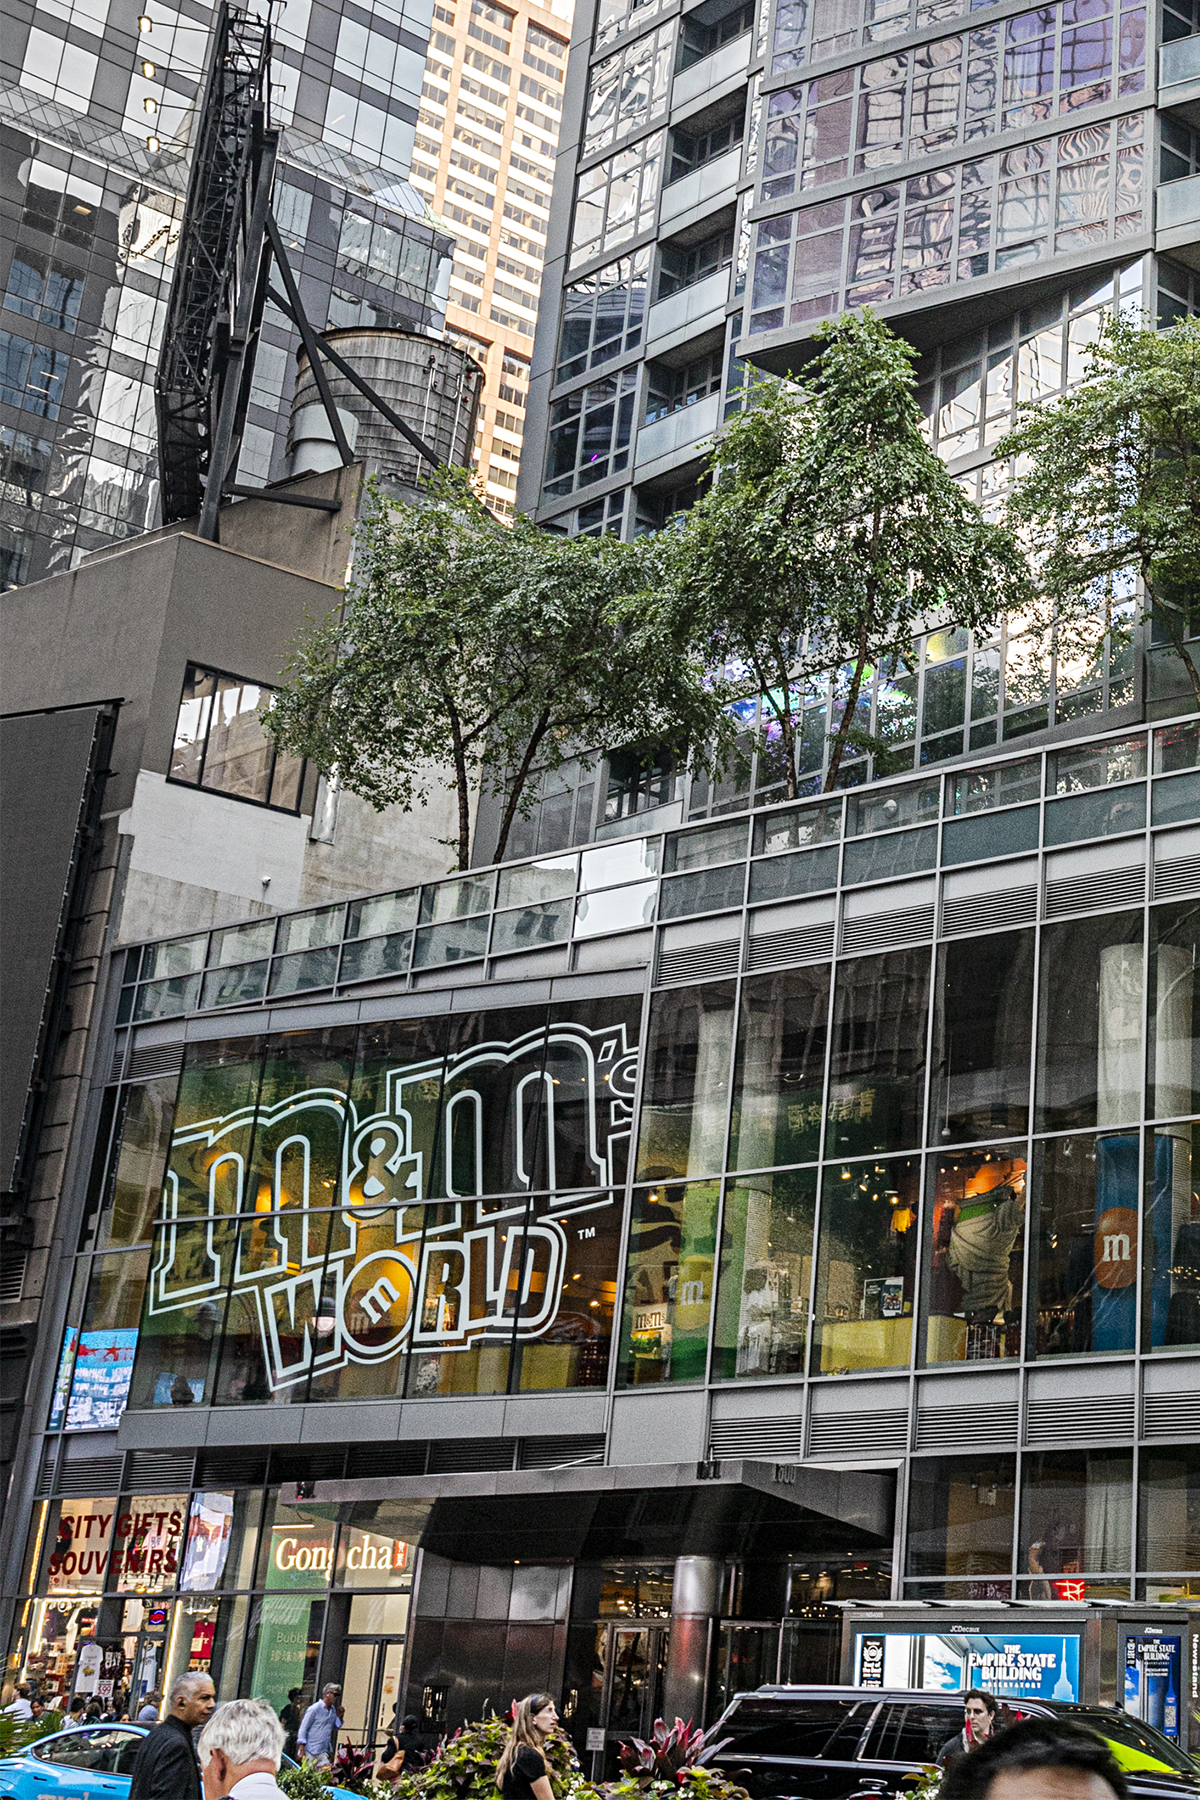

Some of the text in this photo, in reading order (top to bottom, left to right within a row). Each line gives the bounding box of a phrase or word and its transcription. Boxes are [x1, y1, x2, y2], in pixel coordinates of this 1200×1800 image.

[578, 1227, 596, 1240] TM
[1102, 1233, 1131, 1262] m
[264, 1219, 568, 1381] WORLD
[60, 1511, 182, 1539] CITY GIFTS
[347, 1535, 393, 1570] cha
[47, 1549, 178, 1576] SOUVENIRS
[950, 1625, 980, 1633] JCDecaux
[1004, 1645, 1021, 1654] THE
[1138, 1644, 1175, 1653] EMPIRE STATE
[969, 1653, 1056, 1668] EMPIRE STATE
[1144, 1652, 1170, 1660] BUILDING
[981, 1667, 1042, 1680] BUILDING
